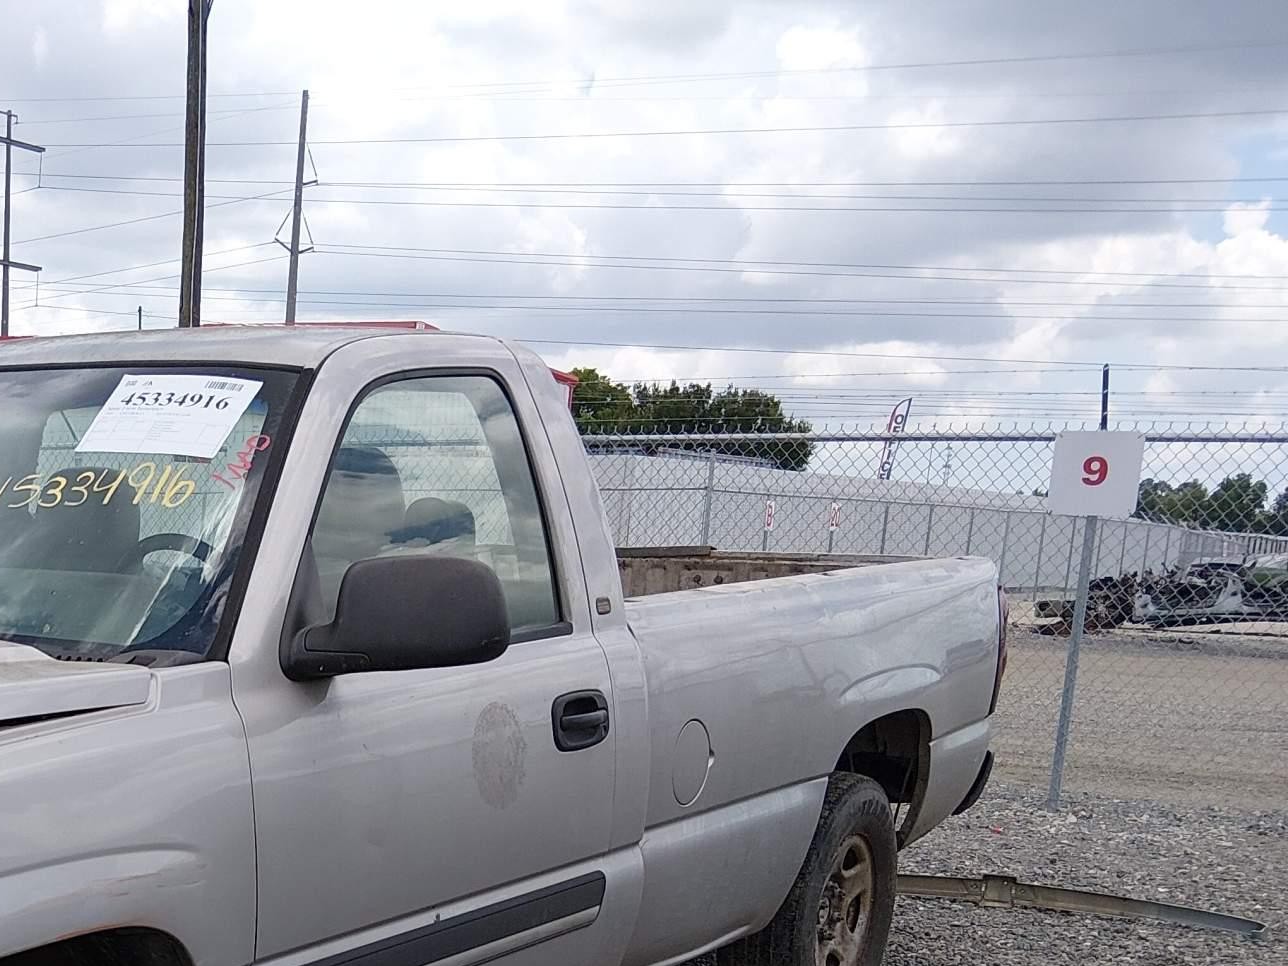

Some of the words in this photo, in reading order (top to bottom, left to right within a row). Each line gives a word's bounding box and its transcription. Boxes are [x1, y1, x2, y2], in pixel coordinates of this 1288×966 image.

[120, 391, 233, 410] 45334916
[879, 413, 905, 480] OFFICE
[1081, 456, 1109, 486] 9
